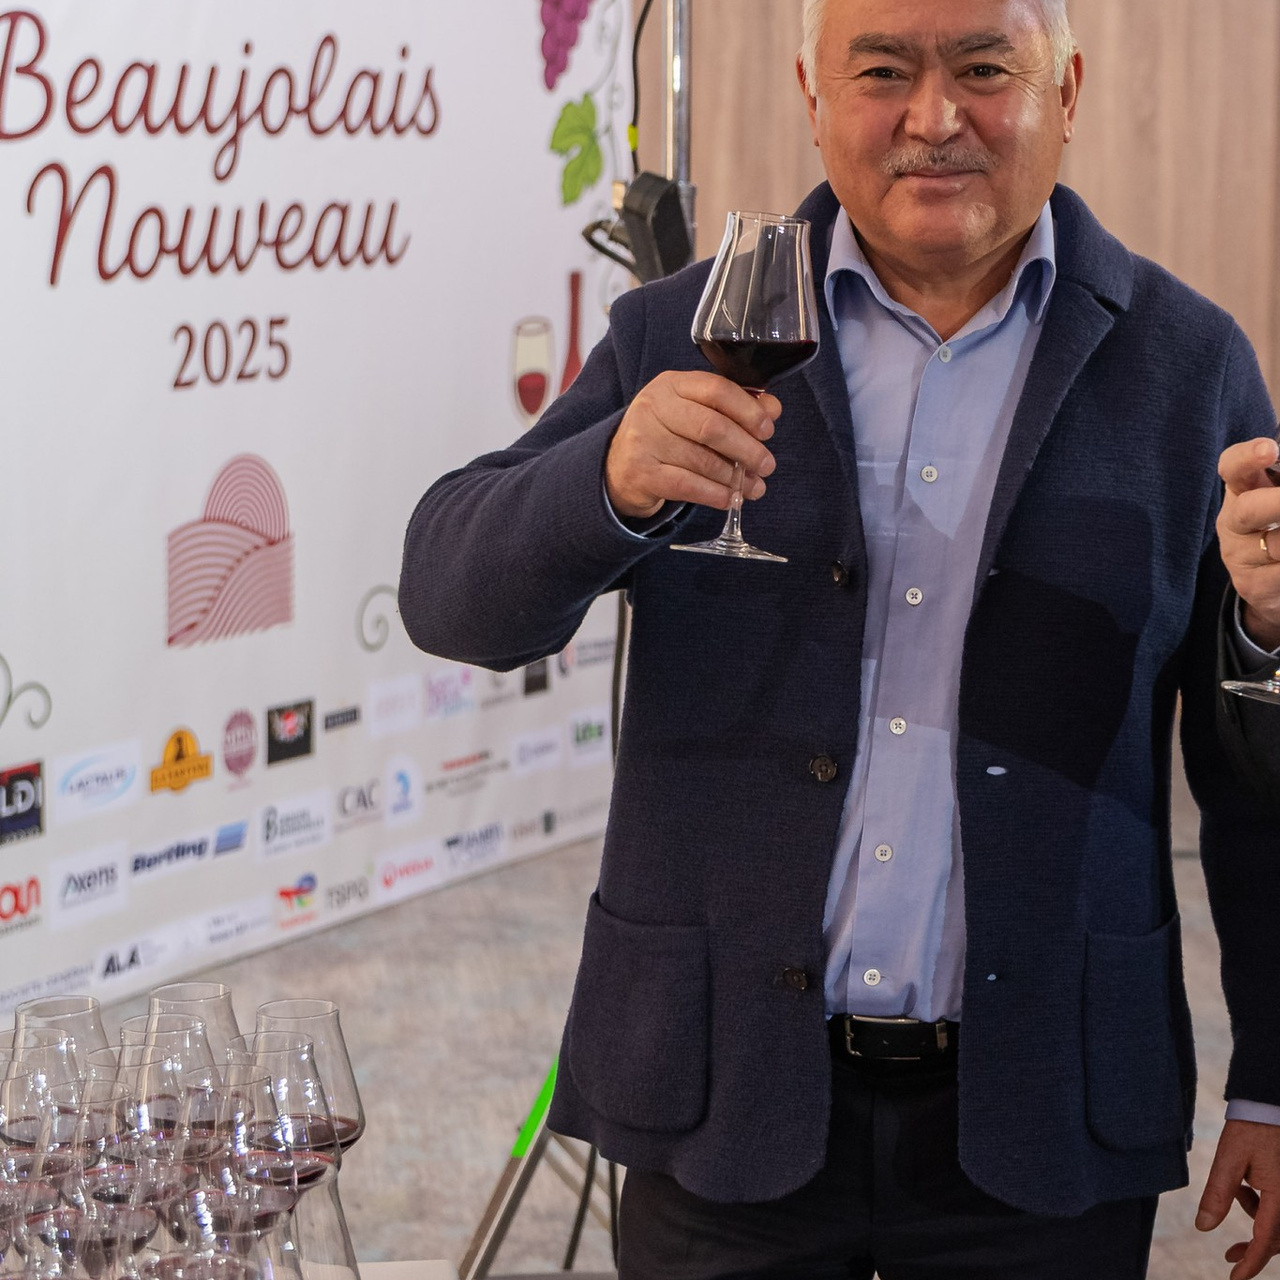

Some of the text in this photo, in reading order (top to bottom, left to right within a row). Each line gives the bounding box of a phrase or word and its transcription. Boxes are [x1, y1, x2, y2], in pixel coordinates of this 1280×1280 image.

[0, 11, 441, 182] Beaujolais
[27, 164, 409, 289] Nouveau
[172, 317, 293, 390] 2025
